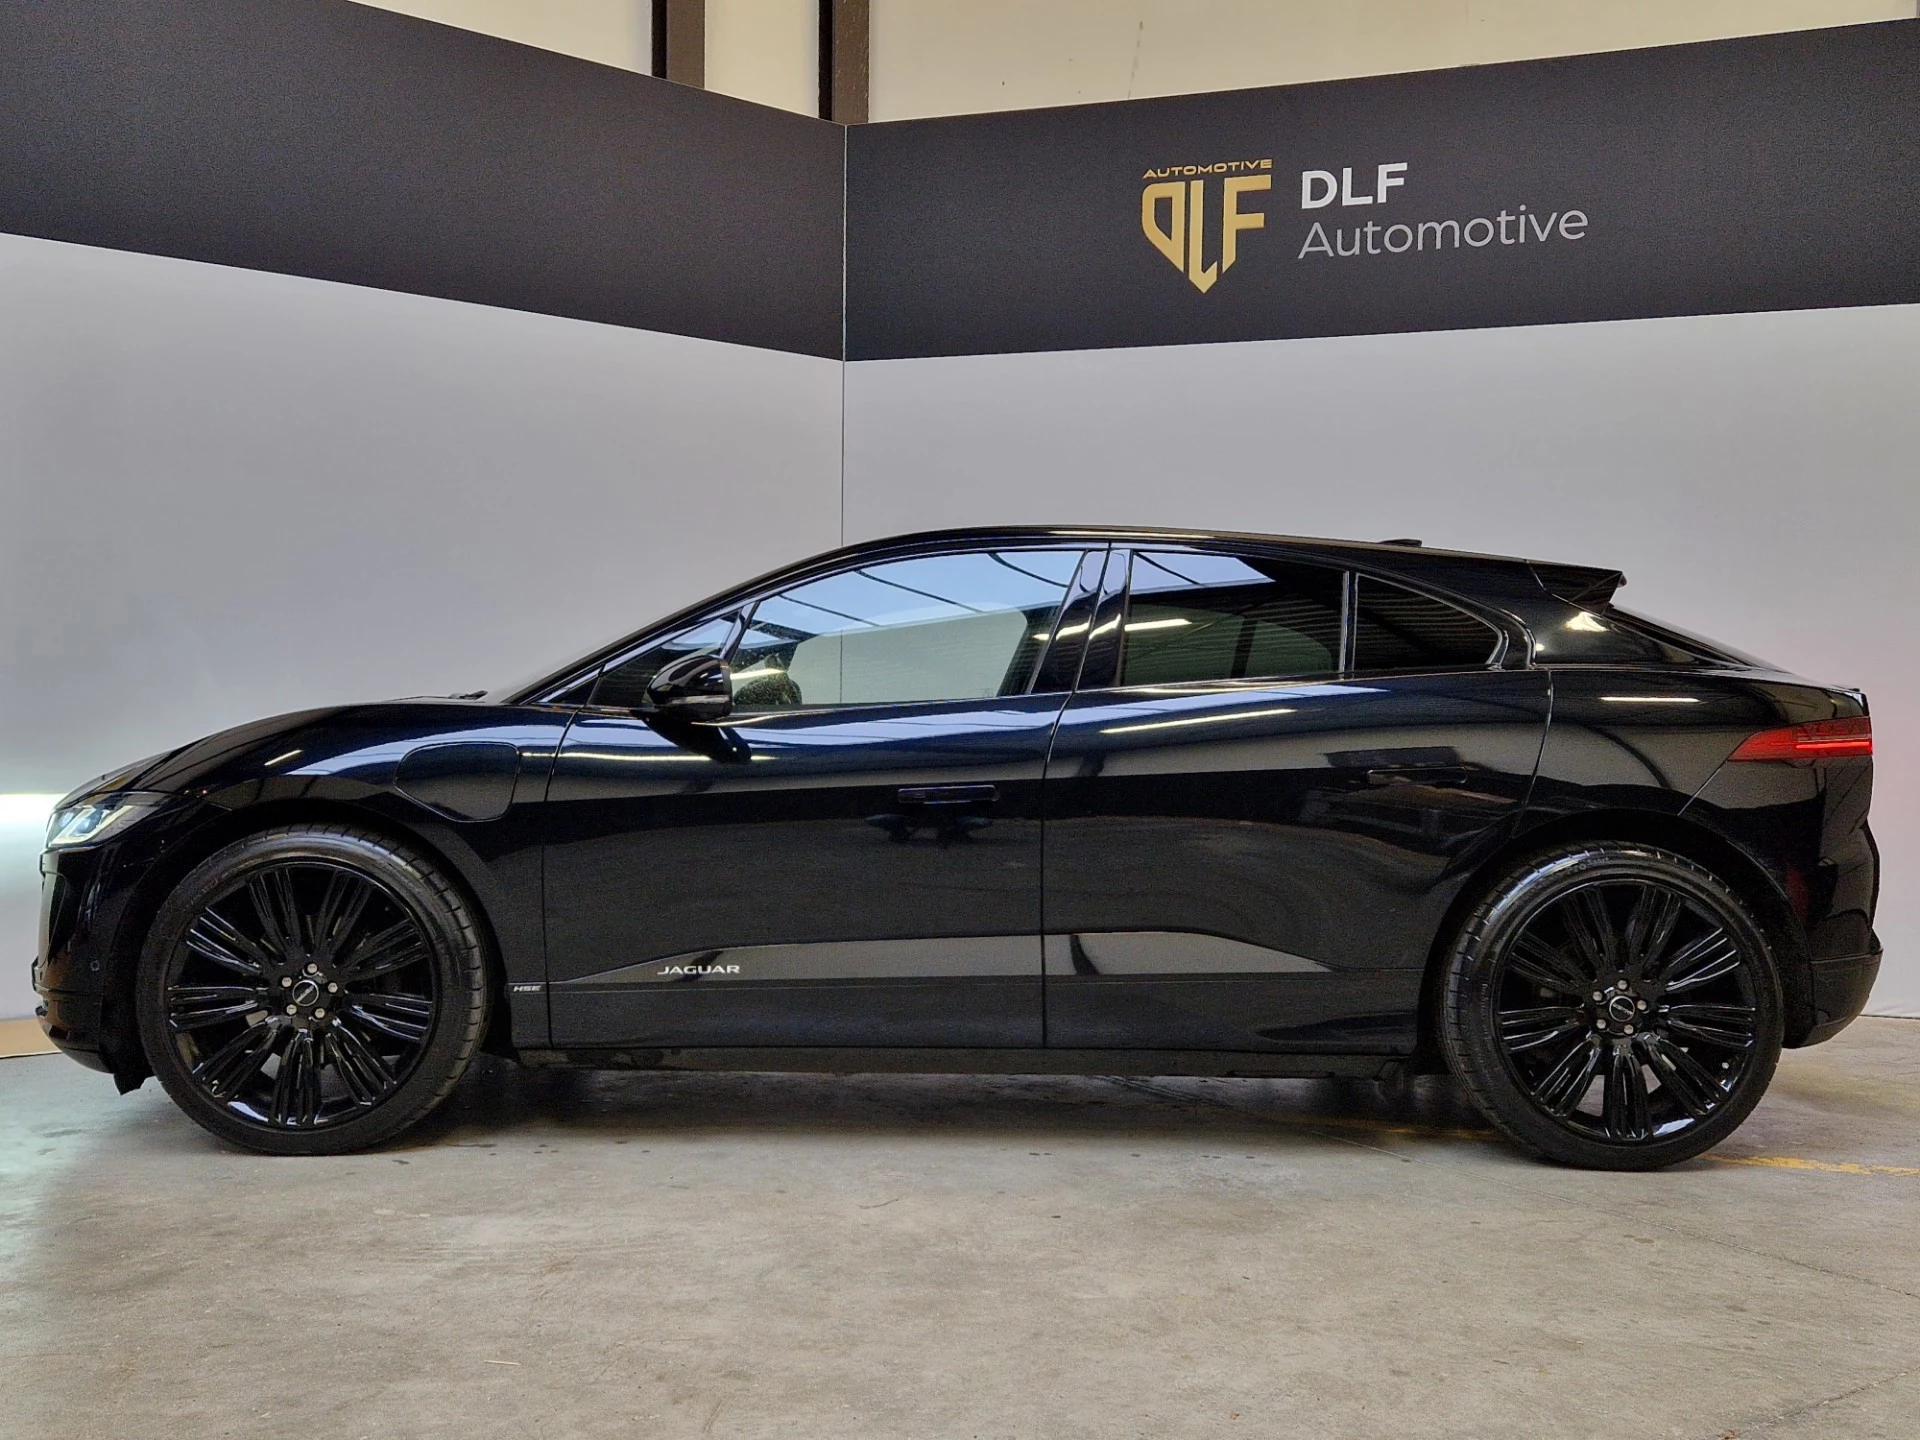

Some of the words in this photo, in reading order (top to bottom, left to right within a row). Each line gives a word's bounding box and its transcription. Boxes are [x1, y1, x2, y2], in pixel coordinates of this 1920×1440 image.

[1142, 158, 1273, 179] AUTOMOTIVE
[1301, 162, 1408, 210] DLF
[1298, 204, 1589, 259] Automotive
[657, 964, 741, 976] JAGUAR
[513, 984, 542, 993] HSE
